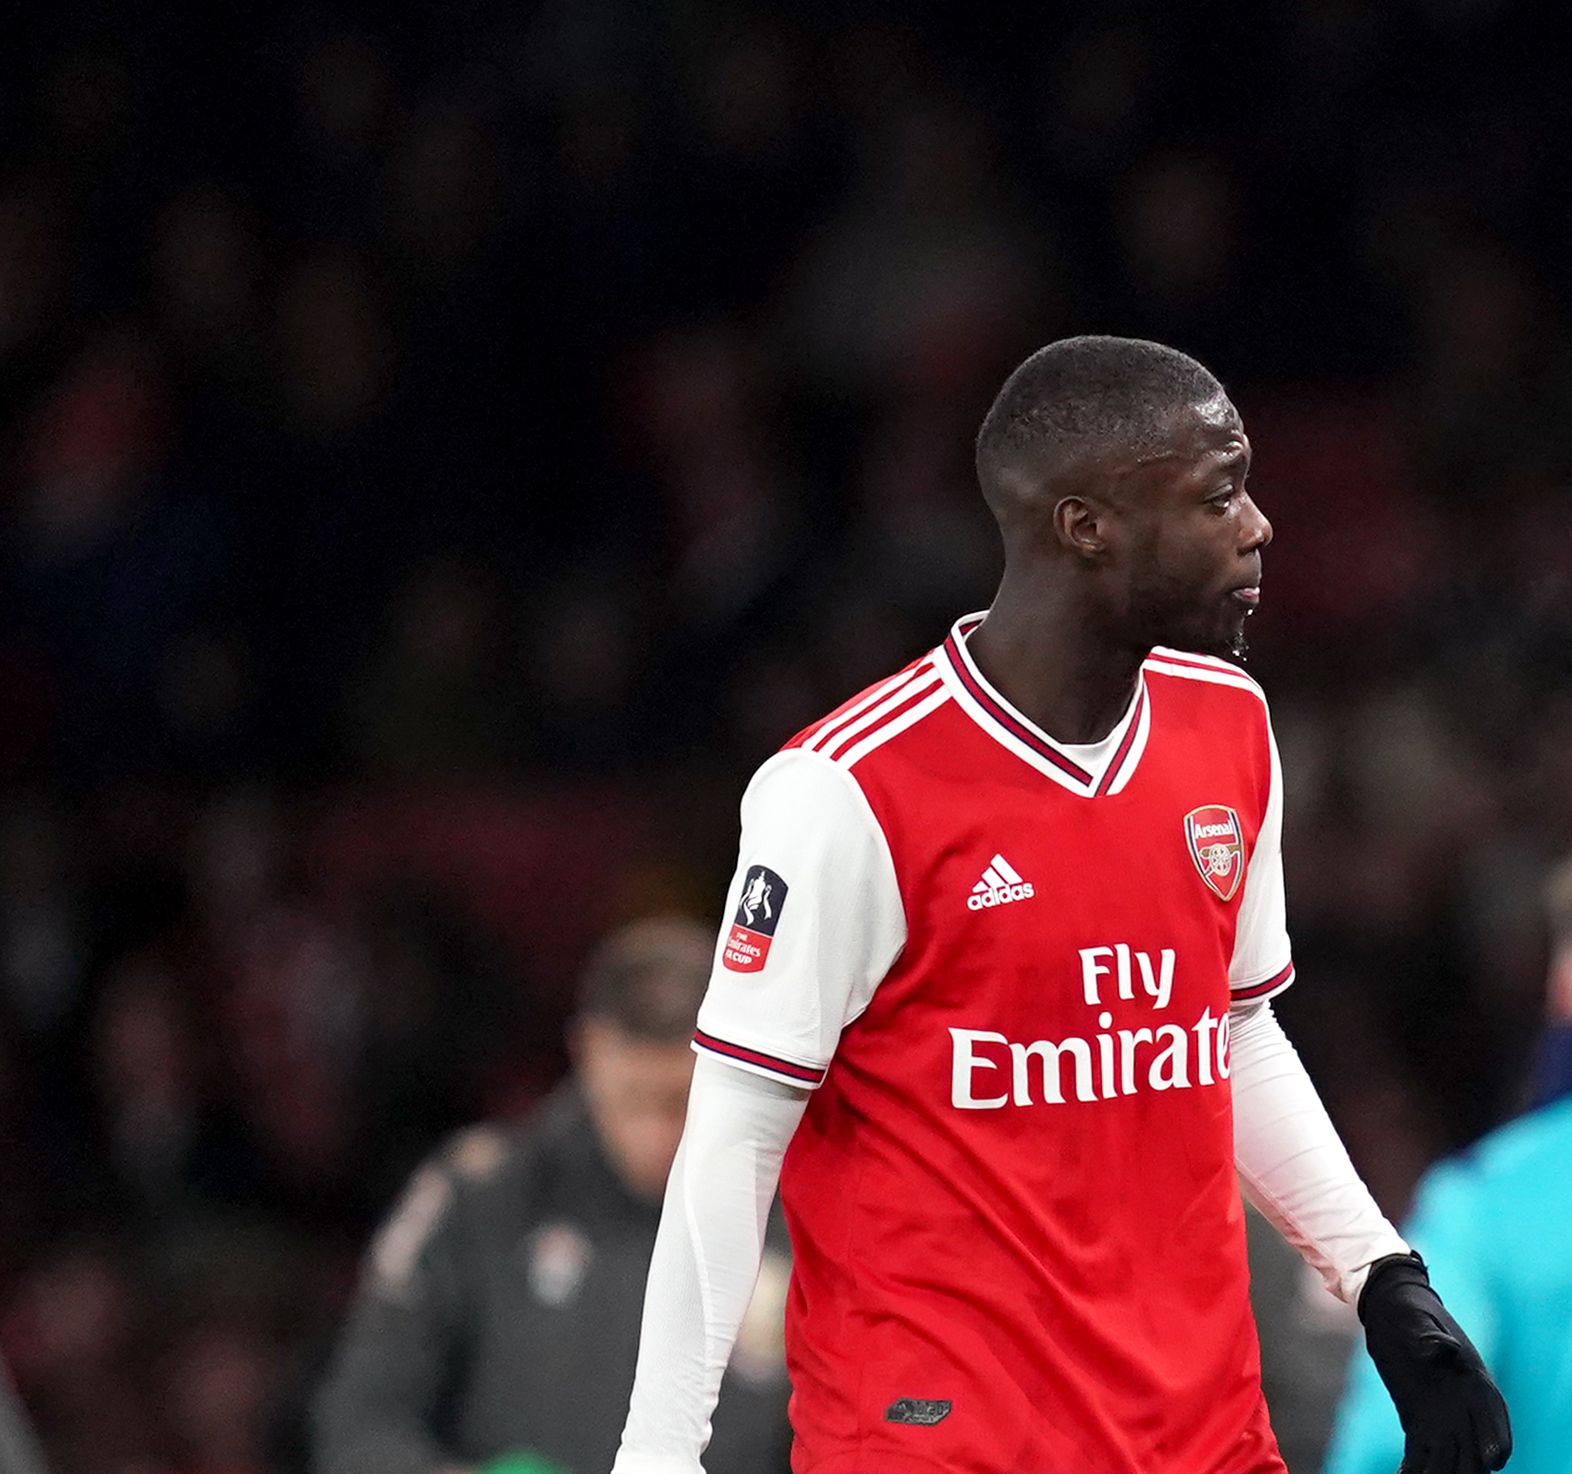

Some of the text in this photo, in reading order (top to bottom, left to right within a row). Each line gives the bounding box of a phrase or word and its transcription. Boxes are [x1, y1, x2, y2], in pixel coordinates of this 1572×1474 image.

[1194, 820, 1234, 839] Arsenal
[967, 882, 1035, 911] adidas
[1078, 943, 1176, 1009] Fly
[948, 1005, 1231, 1110] Emirate
